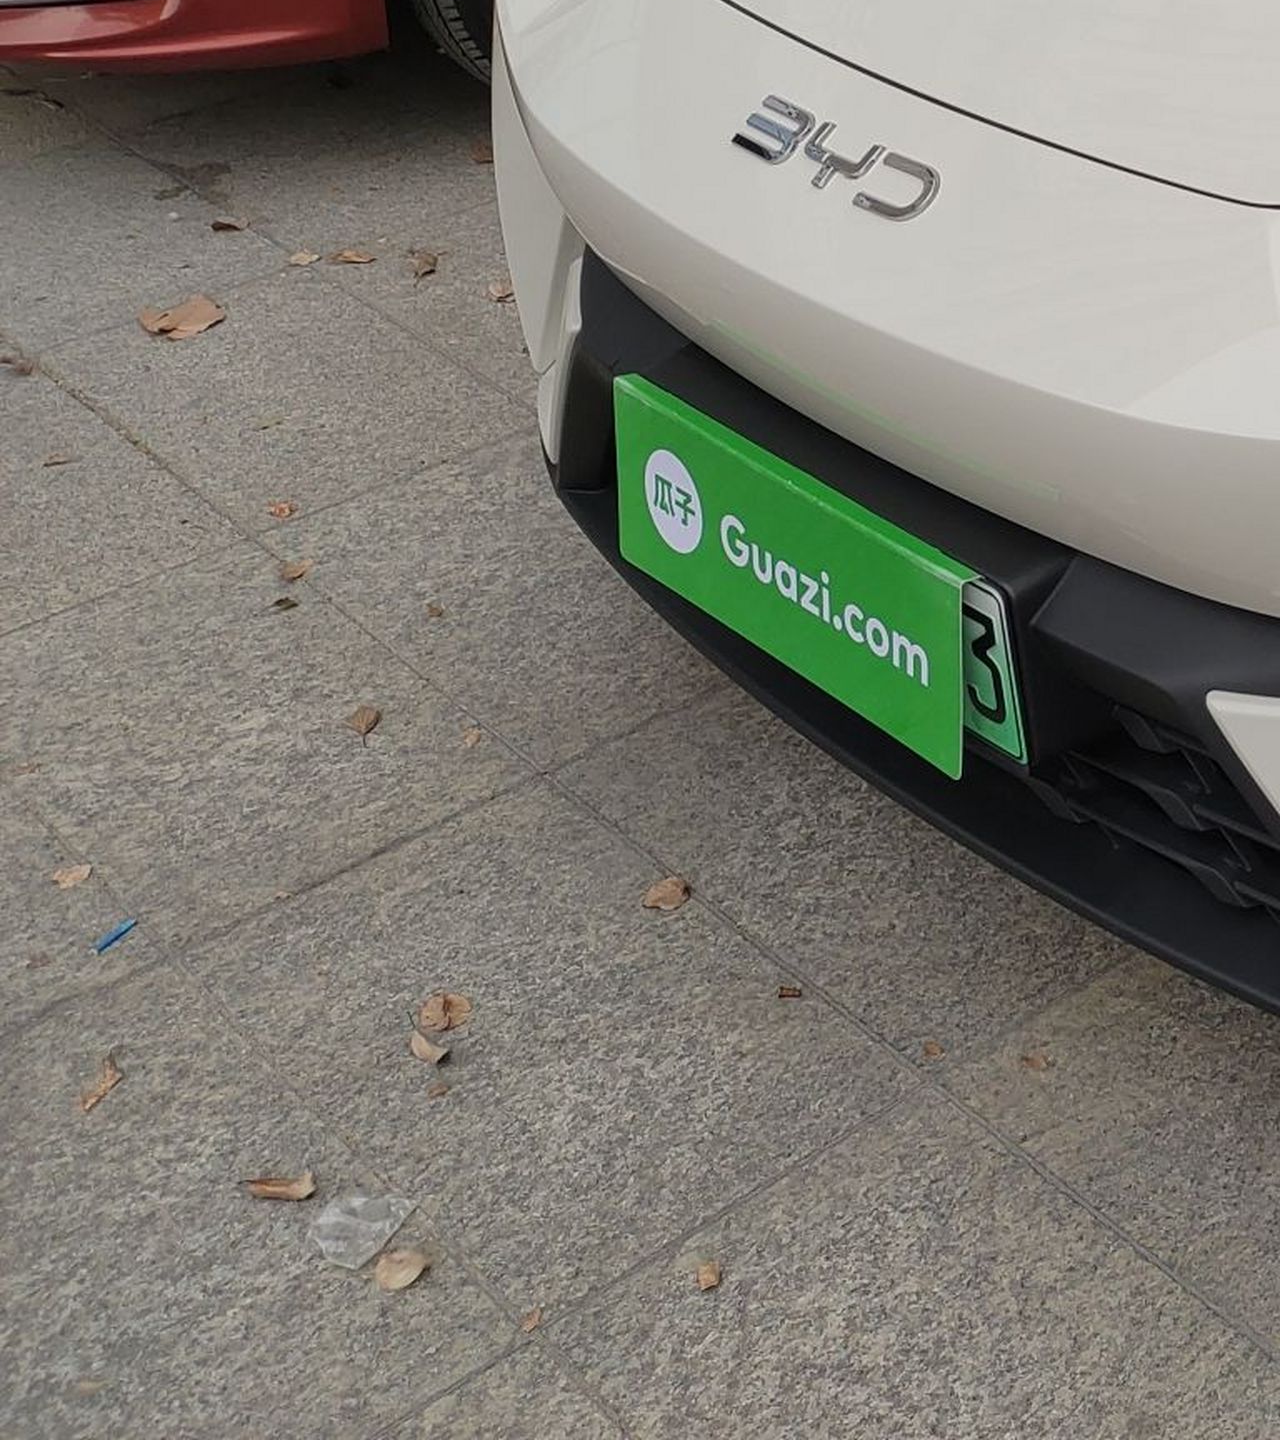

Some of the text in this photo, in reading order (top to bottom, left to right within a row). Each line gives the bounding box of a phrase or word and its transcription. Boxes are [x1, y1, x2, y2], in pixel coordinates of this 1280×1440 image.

[731, 94, 942, 223] BYD
[653, 472, 697, 529] 瓜子
[720, 513, 930, 688] Guazi.com
